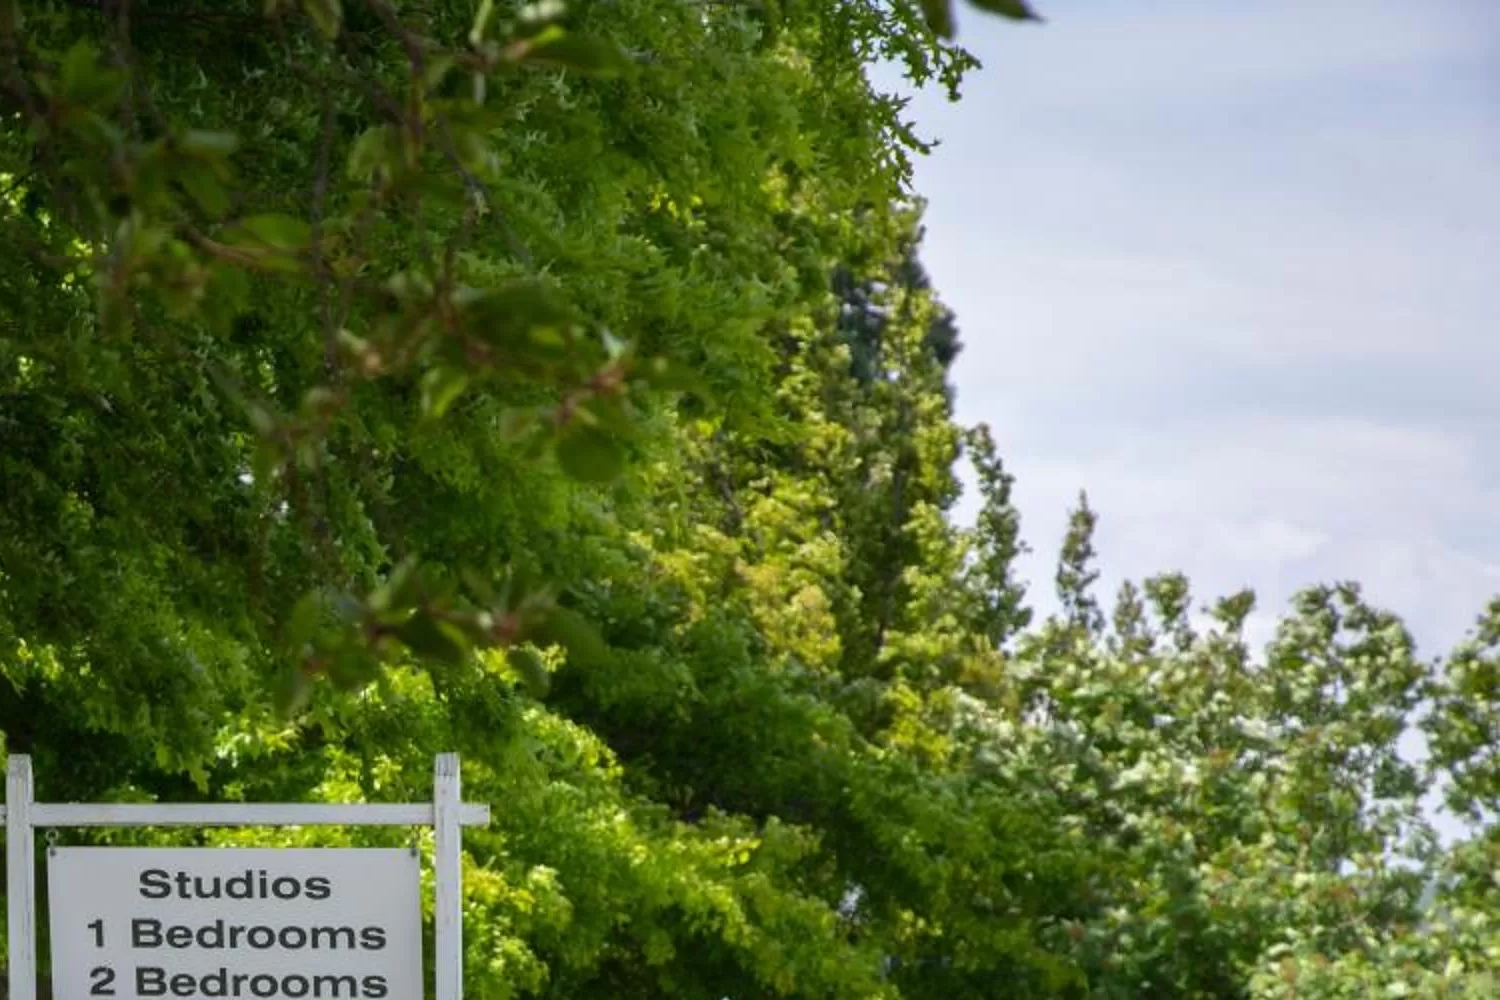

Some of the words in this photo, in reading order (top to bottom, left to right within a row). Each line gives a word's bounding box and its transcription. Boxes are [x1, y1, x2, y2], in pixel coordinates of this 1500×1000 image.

[138, 868, 332, 900] Studios
[86, 919, 104, 947] 1
[131, 918, 387, 950] Bedrooms
[89, 966, 116, 996] 2
[135, 966, 388, 999] Bedrooms
